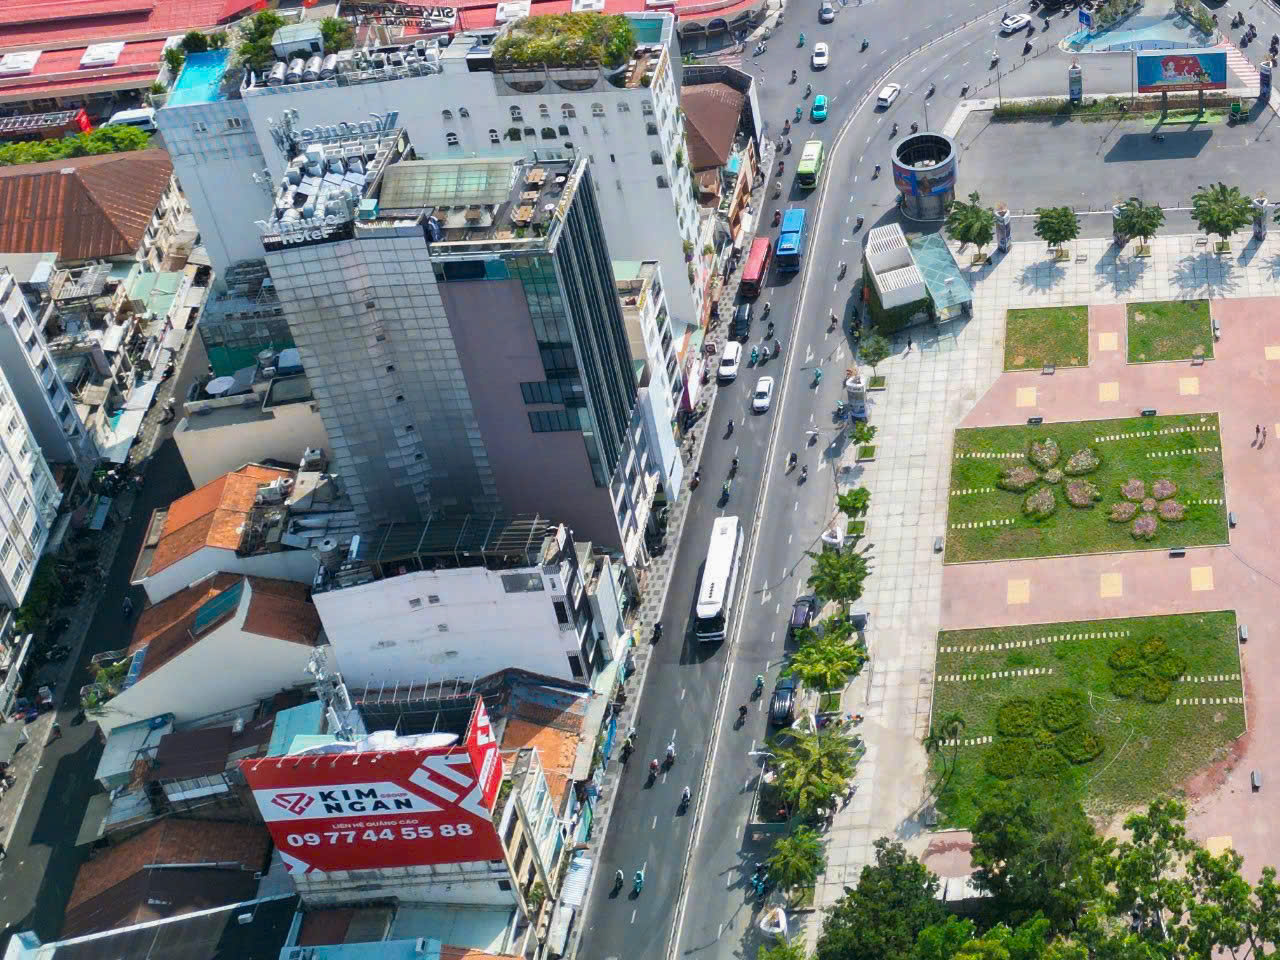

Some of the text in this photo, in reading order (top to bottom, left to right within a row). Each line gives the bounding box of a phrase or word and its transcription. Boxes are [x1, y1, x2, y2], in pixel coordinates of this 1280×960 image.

[318, 788, 377, 802] KIM
[324, 798, 413, 814] NGAN
[287, 823, 473, 847] 09 77 44 55 88
